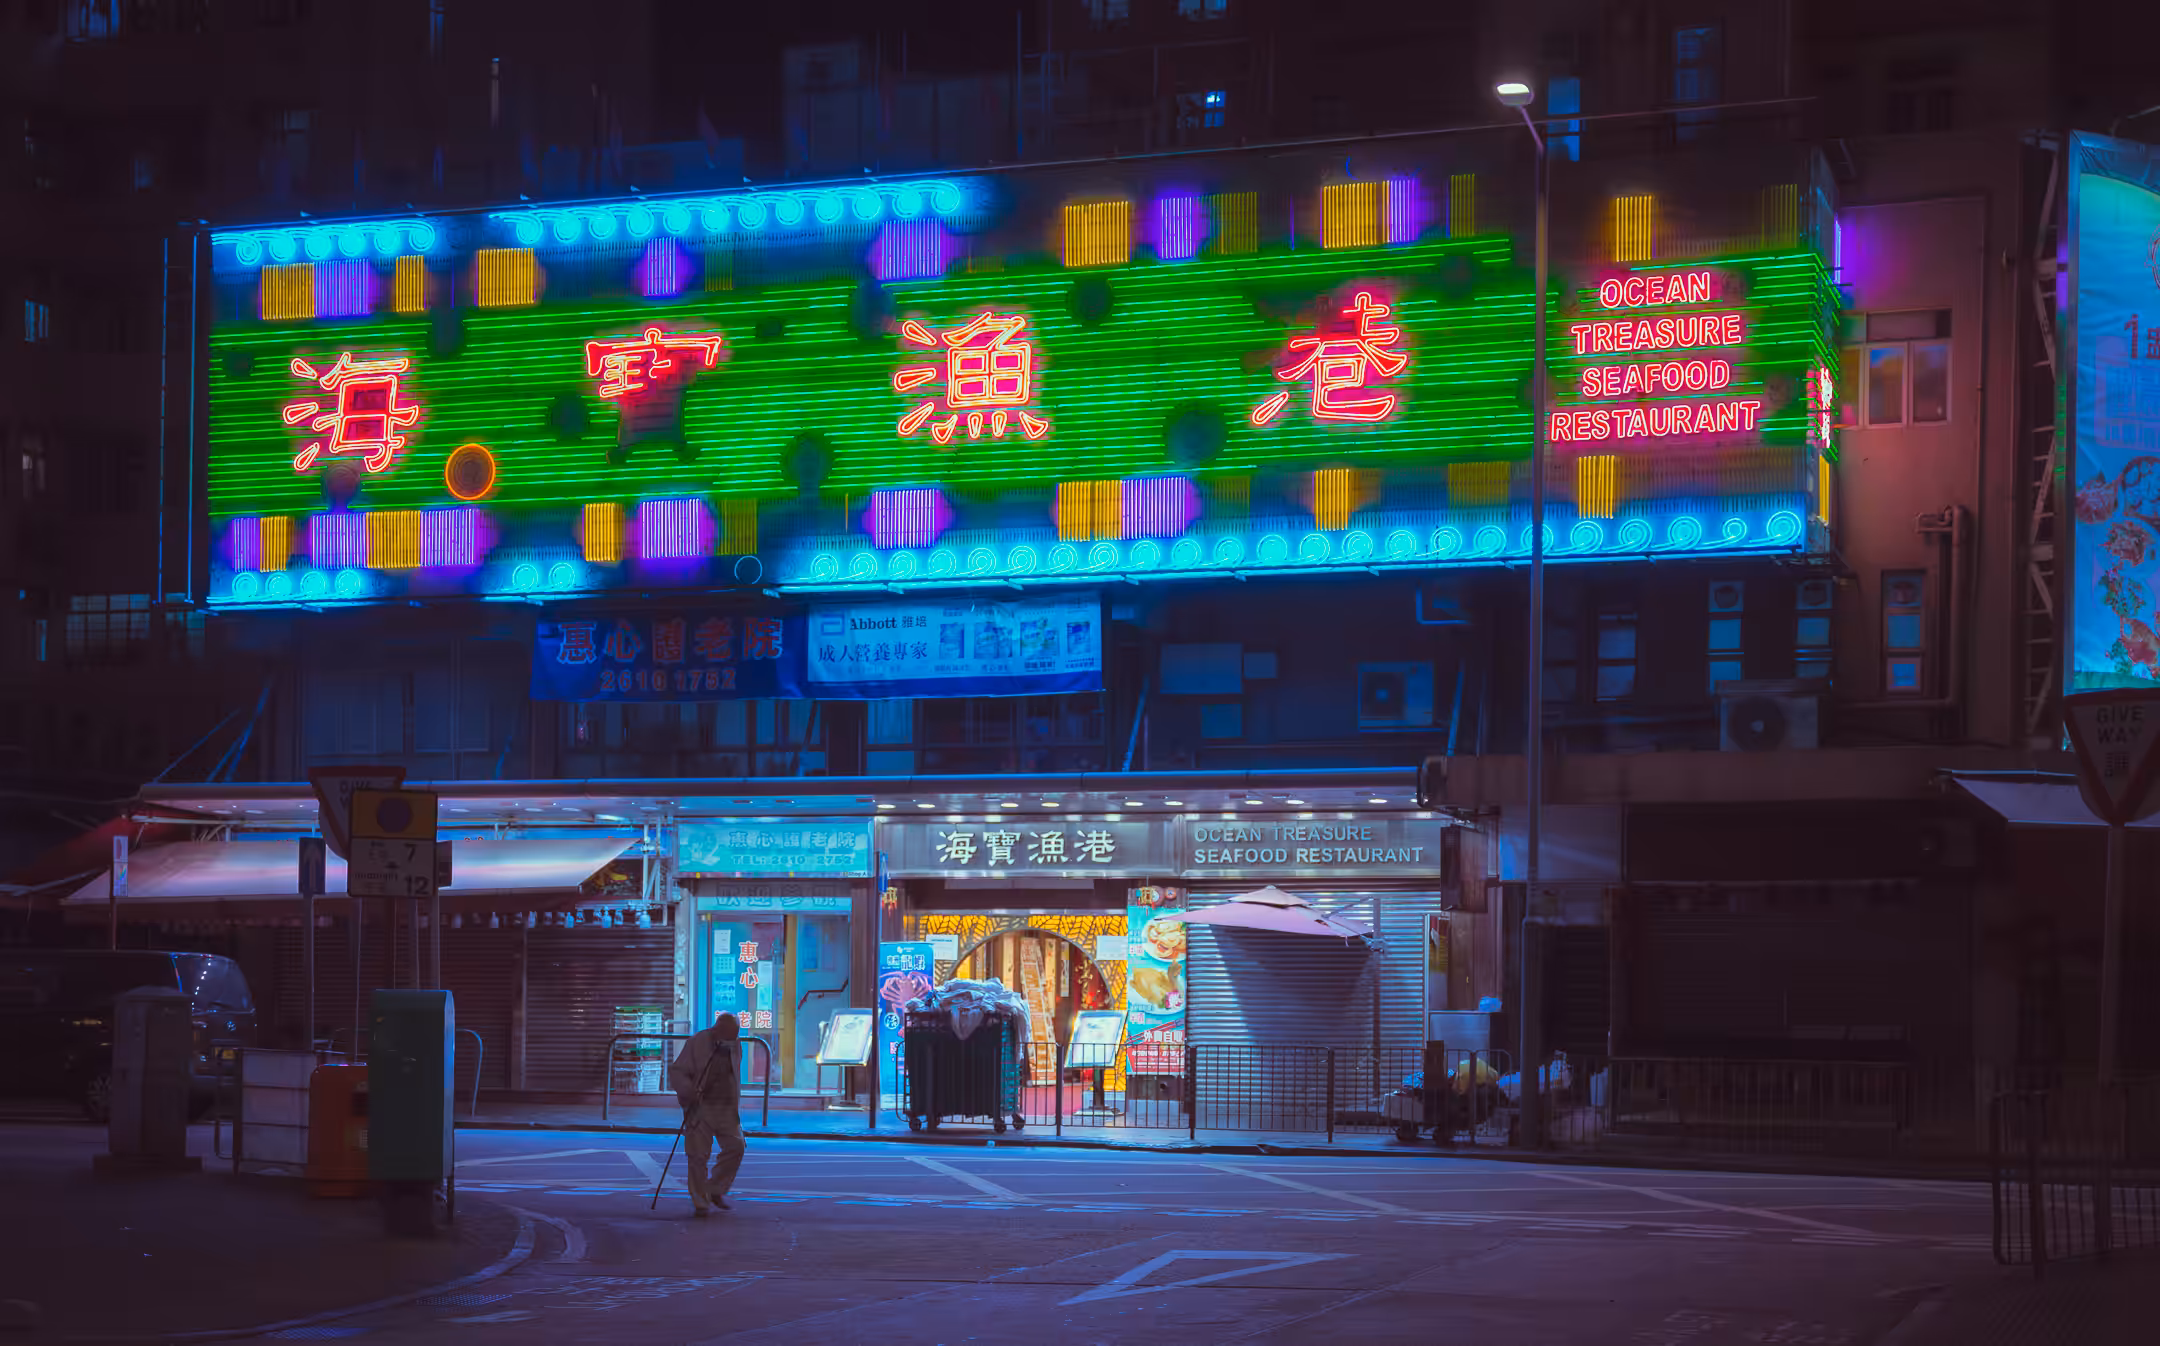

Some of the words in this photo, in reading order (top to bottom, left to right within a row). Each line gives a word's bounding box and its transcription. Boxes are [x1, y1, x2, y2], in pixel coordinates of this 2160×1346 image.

[1600, 272, 1710, 308] OCEAN
[1571, 315, 1741, 354] TREASURE
[1582, 360, 1730, 396] SEAFOOD
[1551, 401, 1760, 441] RESTAURANT
[850, 616, 898, 631] Abbott
[2096, 705, 2144, 724] GIVE
[2097, 727, 2143, 744] WAY
[1194, 827, 1262, 843] OCEAN
[1272, 825, 1372, 842] TREASURE
[403, 843, 418, 862] 7
[936, 829, 1116, 867] 海寶漁港
[1194, 849, 1288, 864] SEAFOOD
[1296, 847, 1424, 864] RESTAURANT
[404, 875, 430, 895] 12
[738, 940, 759, 989] 惠心
